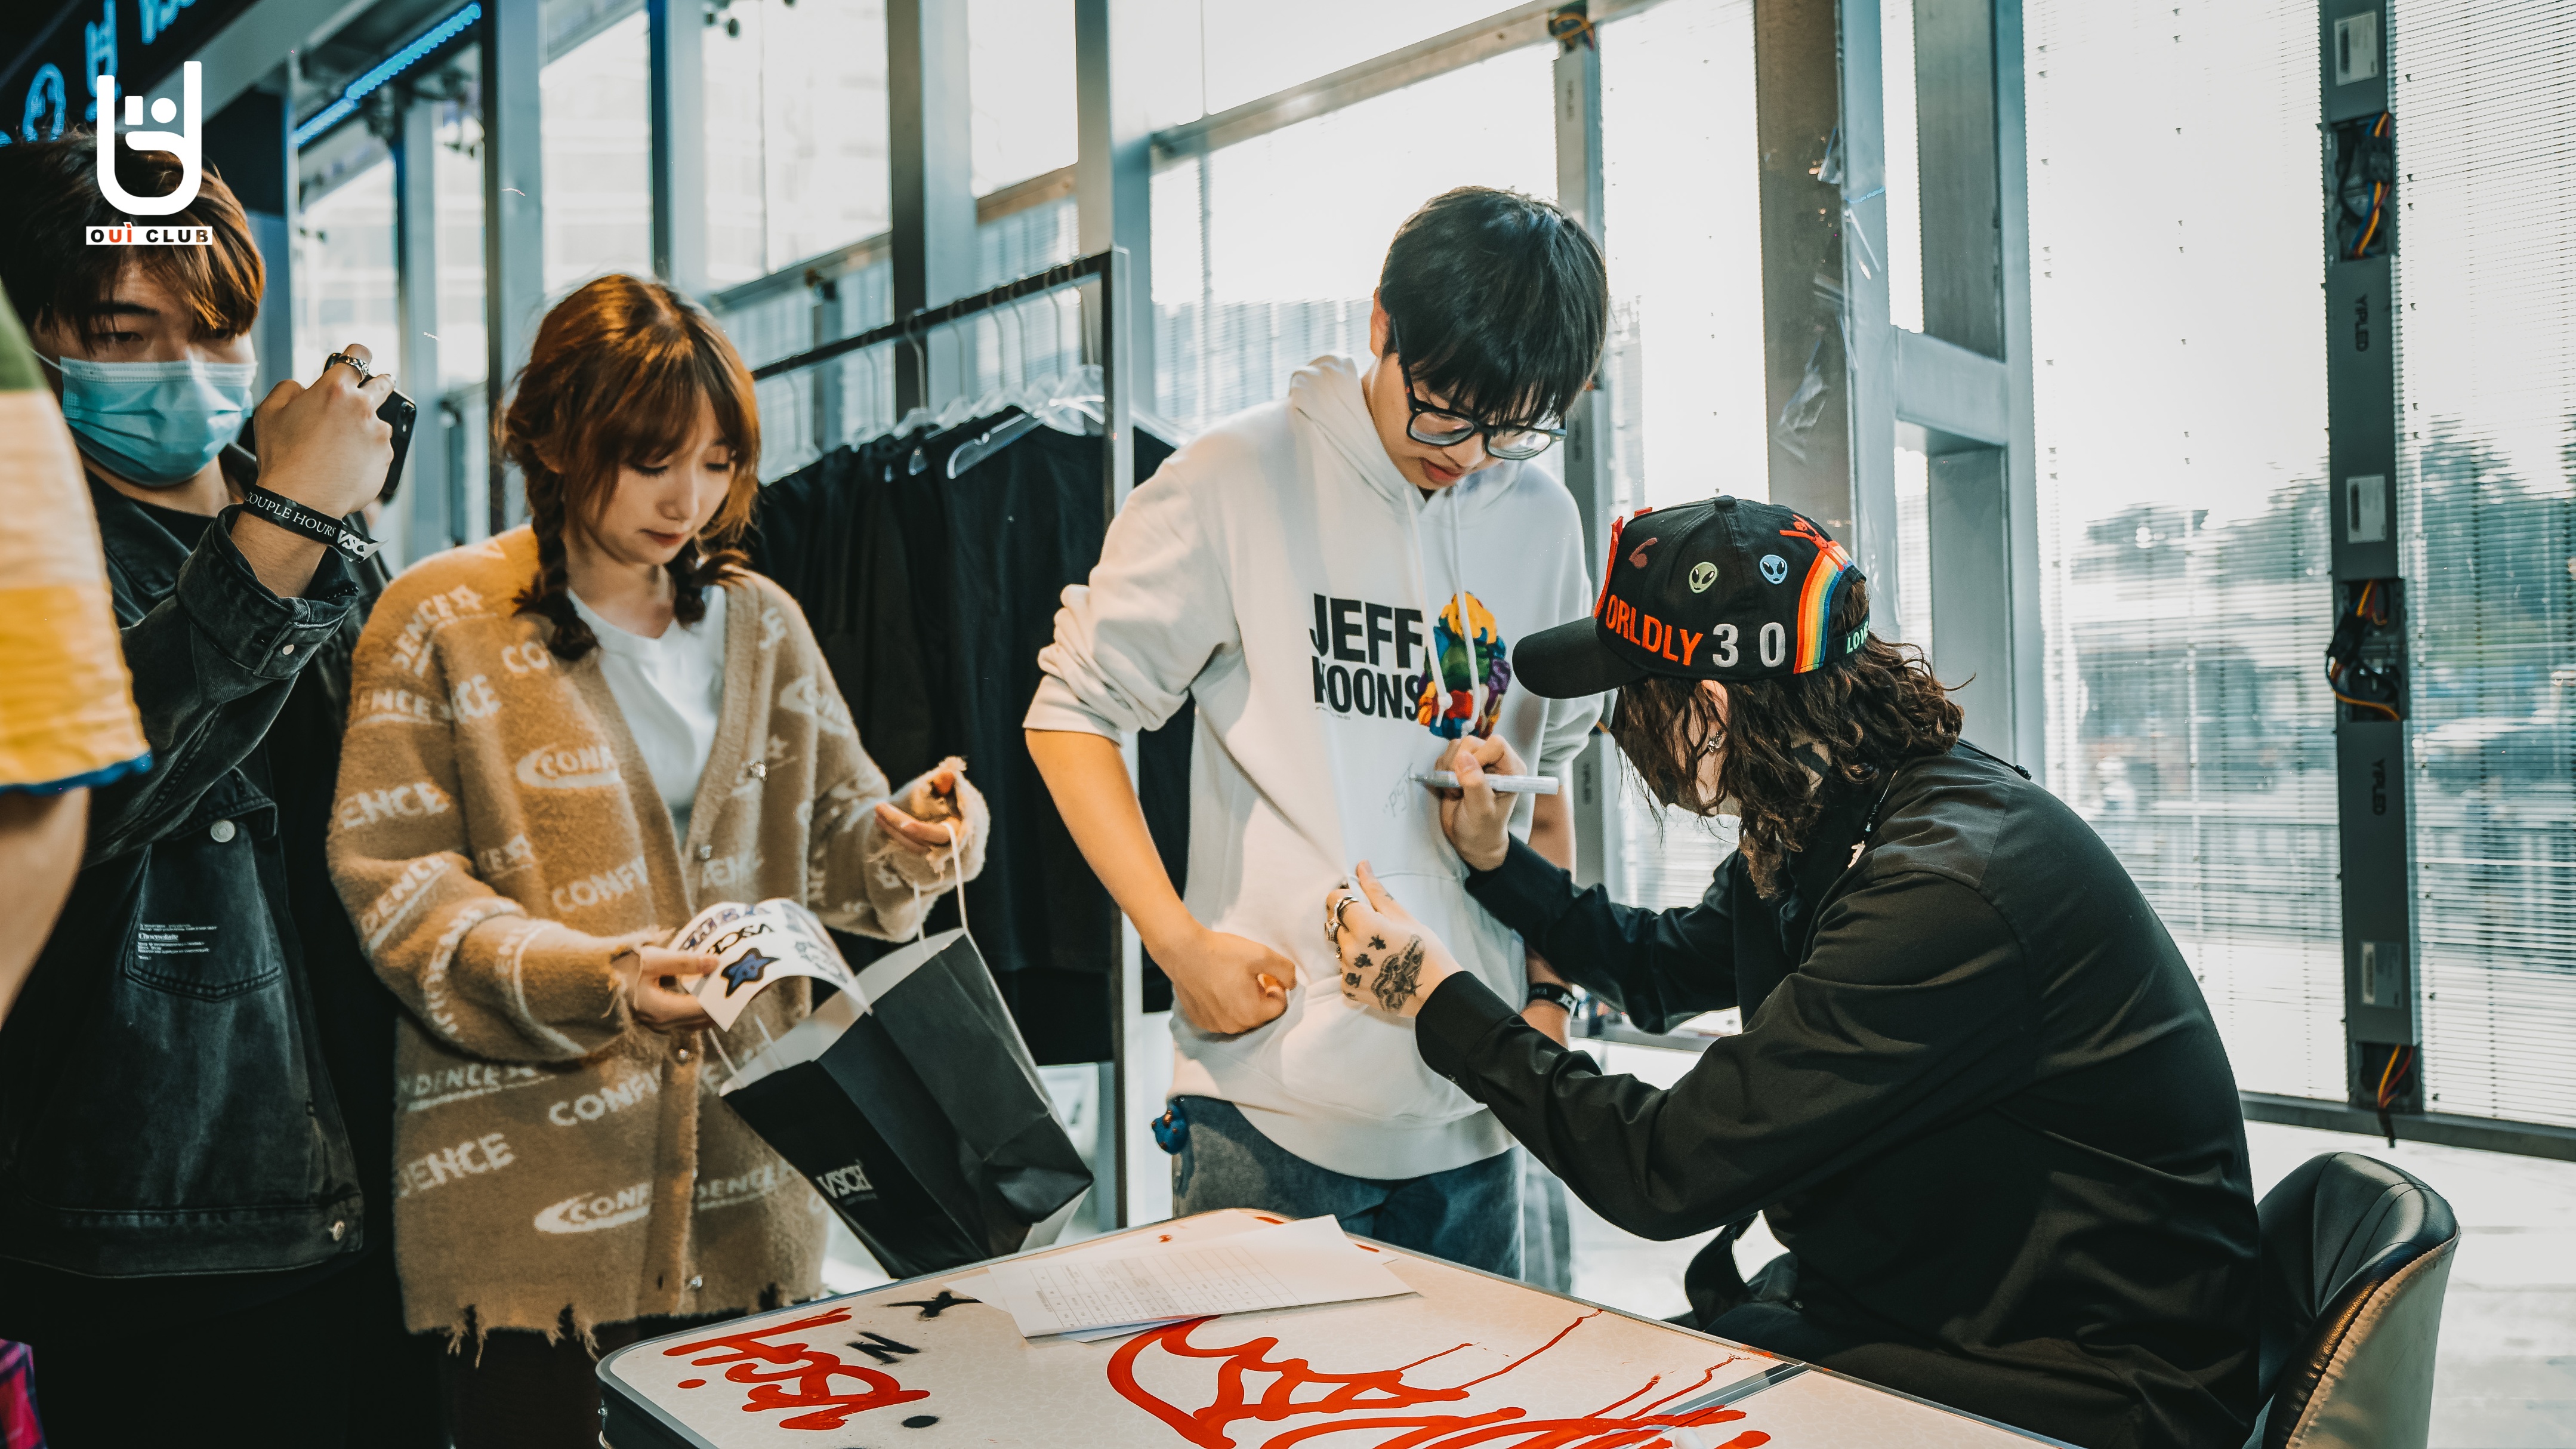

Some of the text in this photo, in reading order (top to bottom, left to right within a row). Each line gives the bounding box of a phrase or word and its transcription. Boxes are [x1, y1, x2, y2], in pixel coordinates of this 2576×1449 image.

[292, 512, 337, 537] HOURS
[337, 529, 369, 557] VSC
[1309, 593, 1424, 668] JEFF
